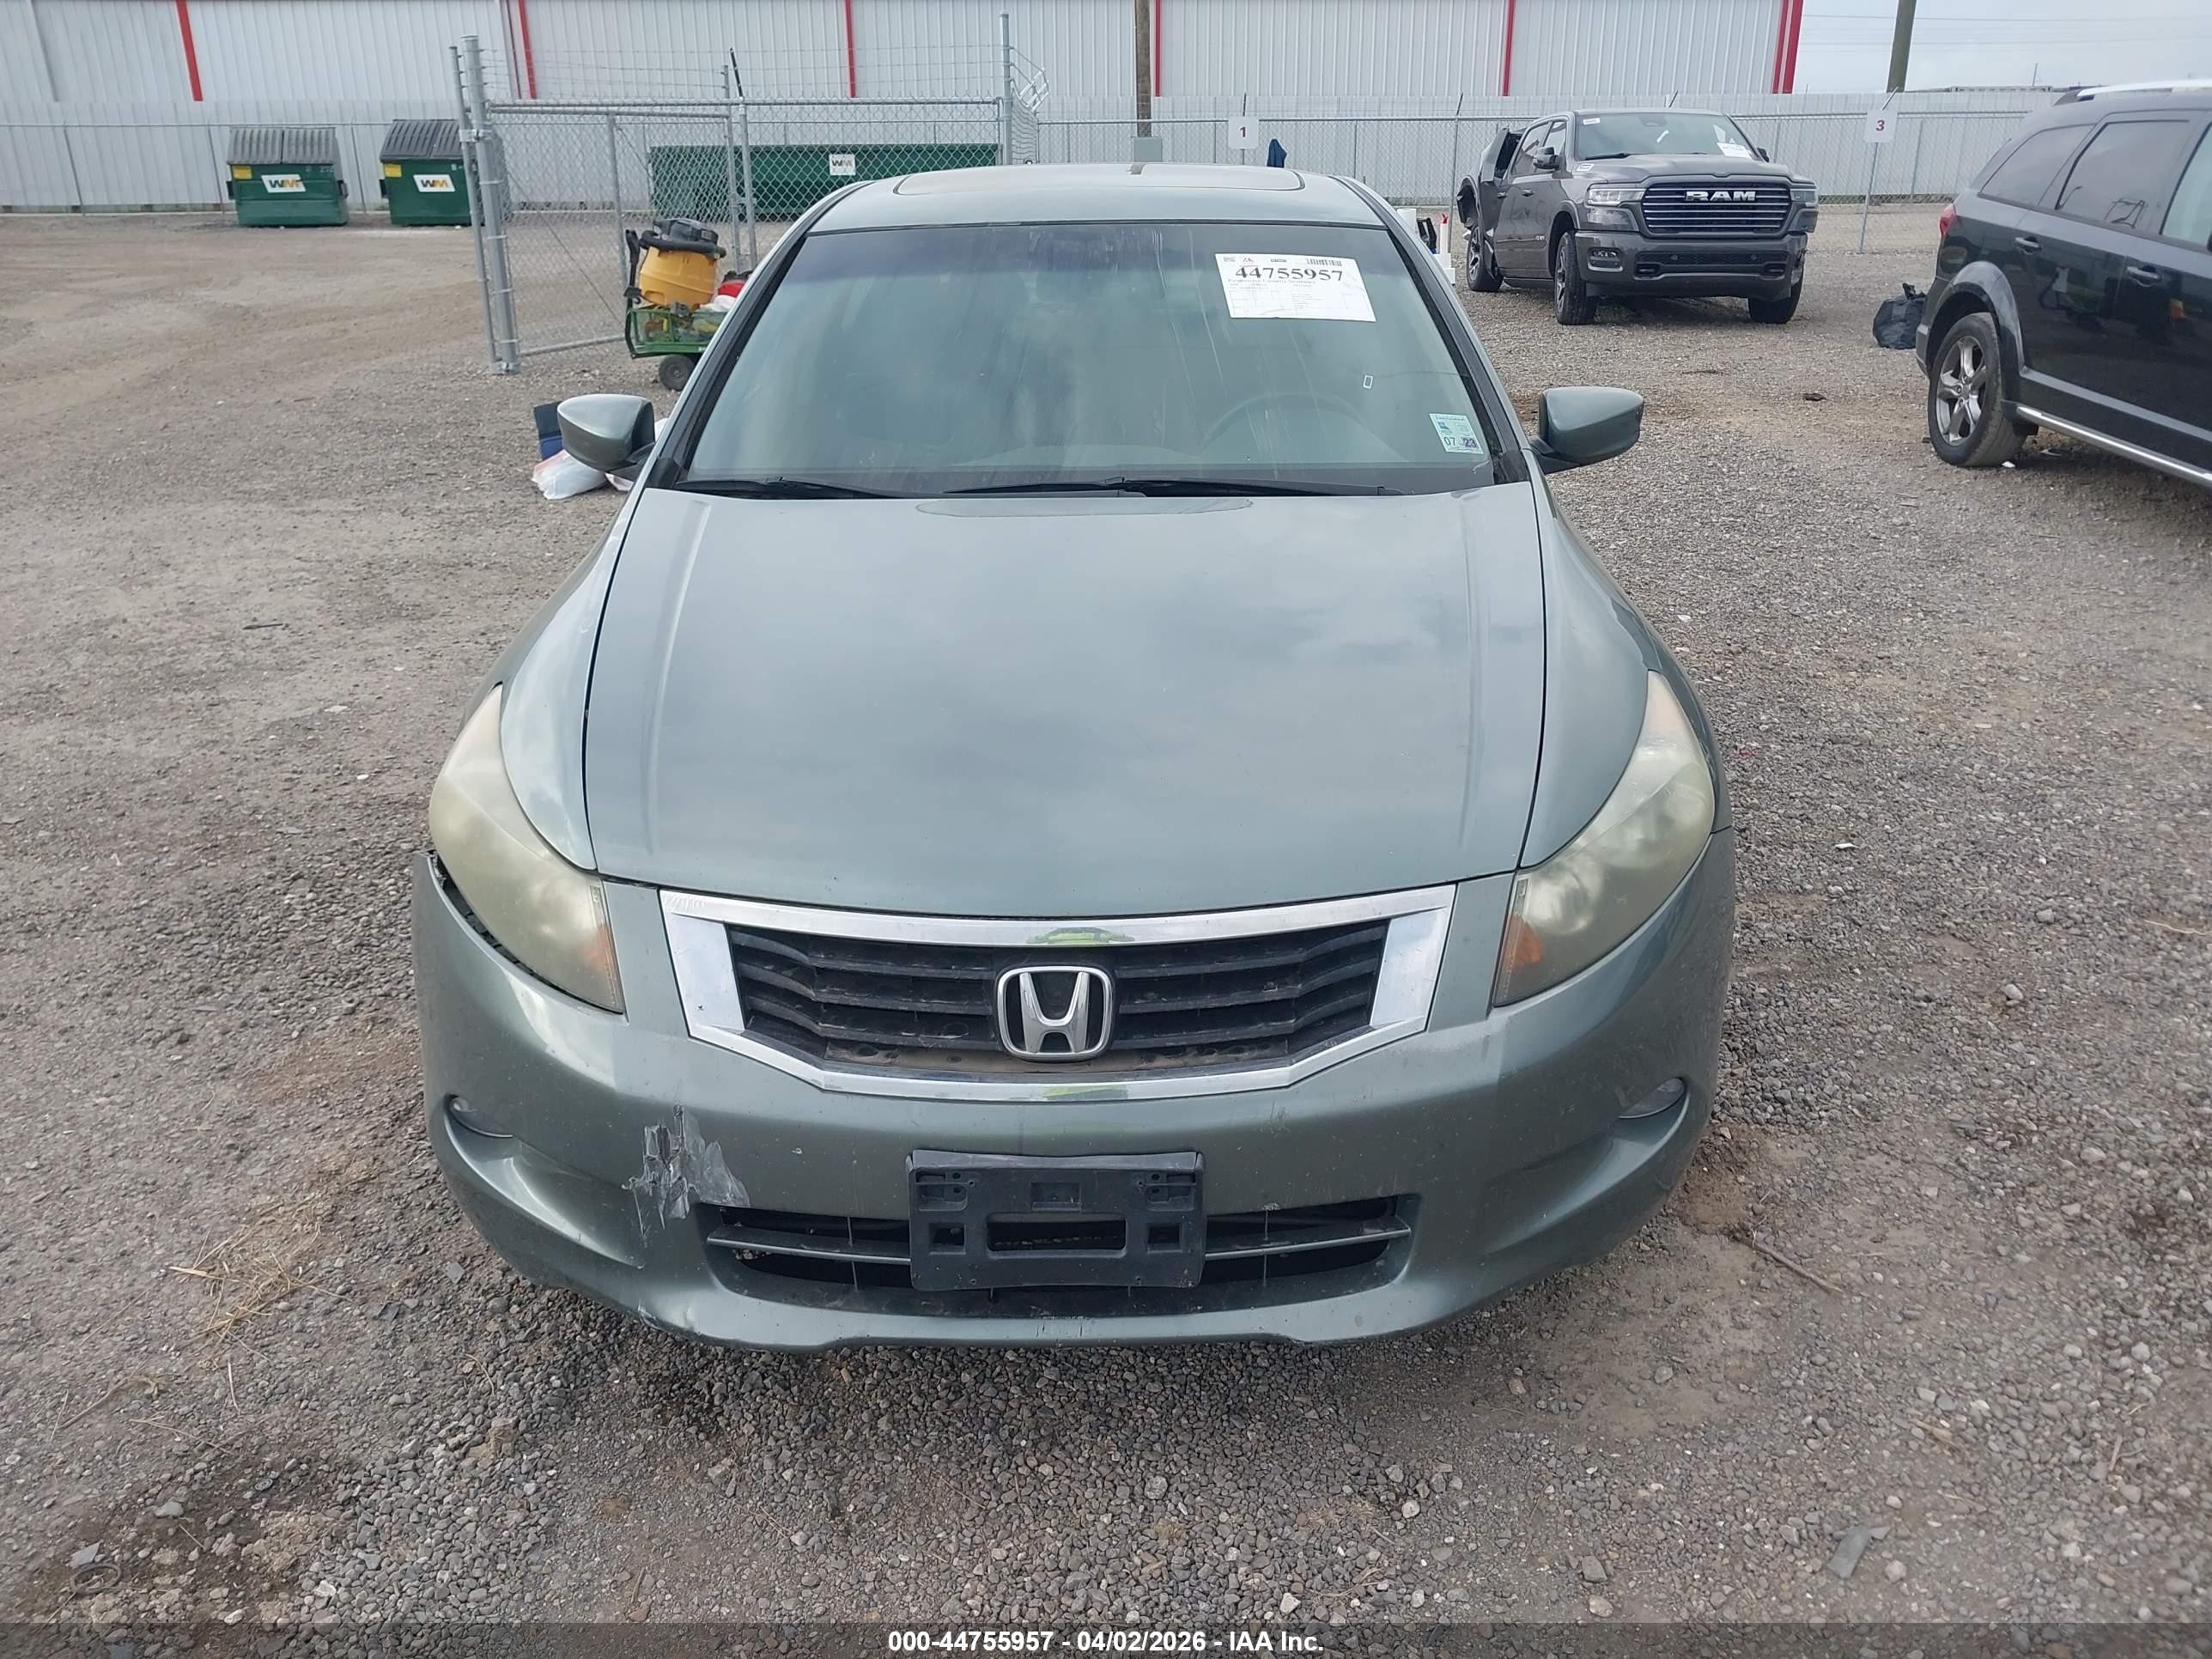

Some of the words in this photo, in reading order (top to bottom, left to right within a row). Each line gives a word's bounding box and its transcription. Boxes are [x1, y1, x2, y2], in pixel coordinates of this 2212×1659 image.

[1875, 119, 1885, 131] 3
[1240, 126, 1246, 137] 1
[269, 179, 301, 188] WM
[421, 179, 448, 188] WM
[1686, 191, 1756, 201] RAM
[1235, 267, 1343, 282] 44755957
[1443, 436, 1455, 446] 07
[1463, 437, 1477, 448] 23
